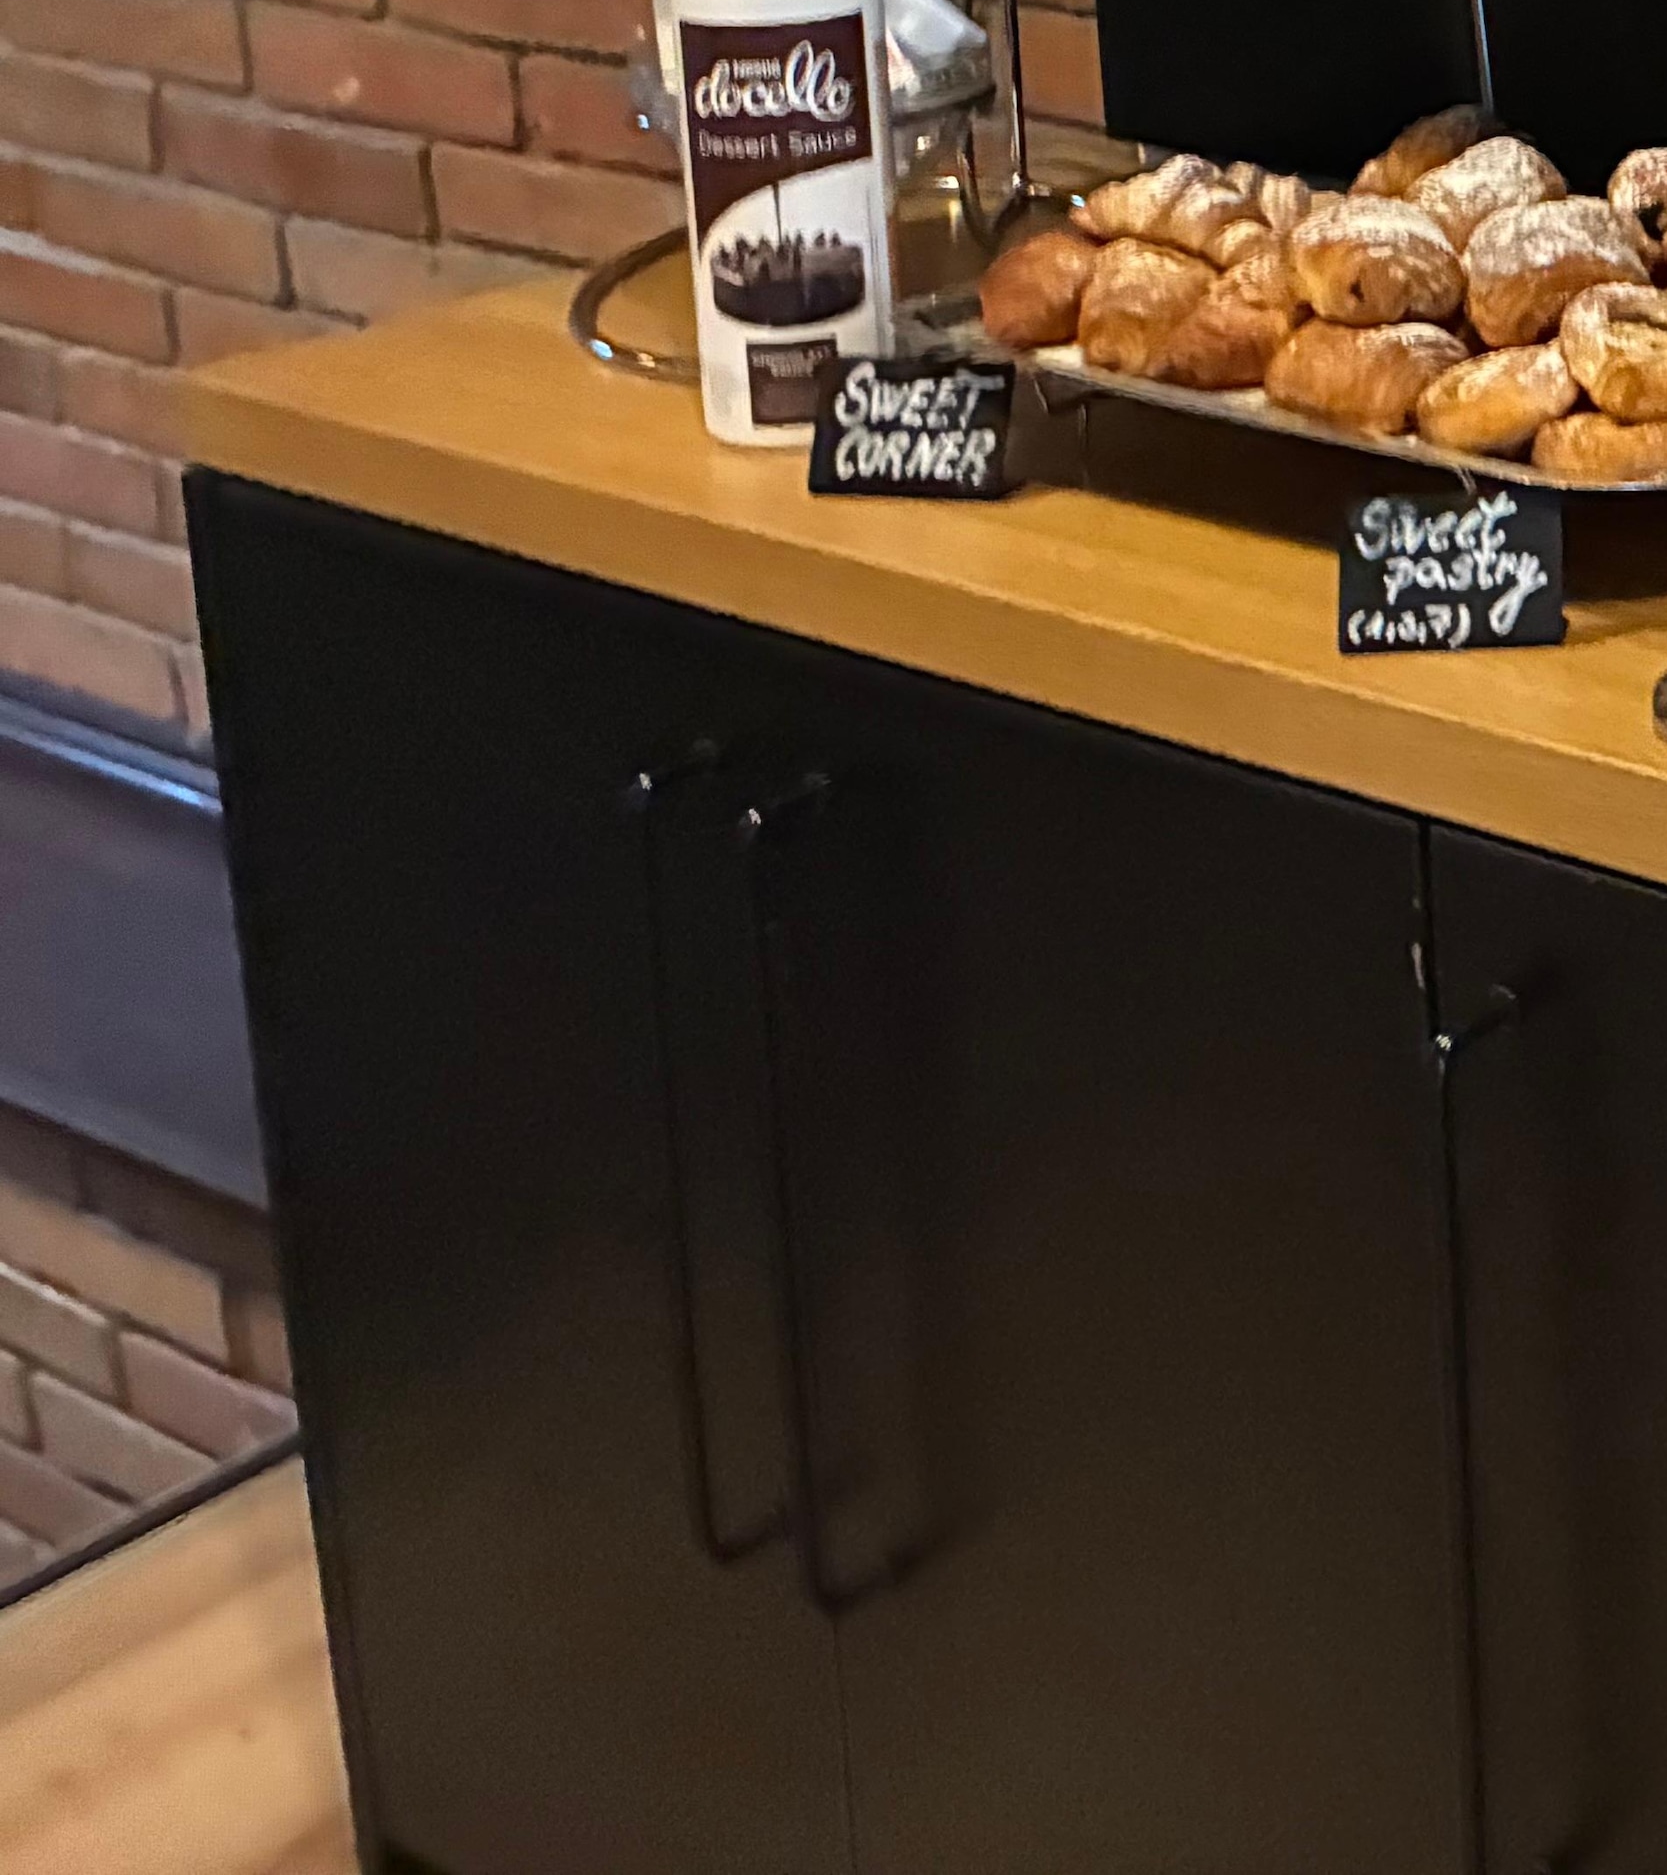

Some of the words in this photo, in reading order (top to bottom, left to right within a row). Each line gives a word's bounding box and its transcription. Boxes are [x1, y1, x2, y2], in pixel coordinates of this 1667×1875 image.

[835, 361, 1006, 430] SWEET
[835, 426, 996, 487] CORNER
[1354, 491, 1519, 561] Sweet
[1383, 549, 1549, 636] pastry
